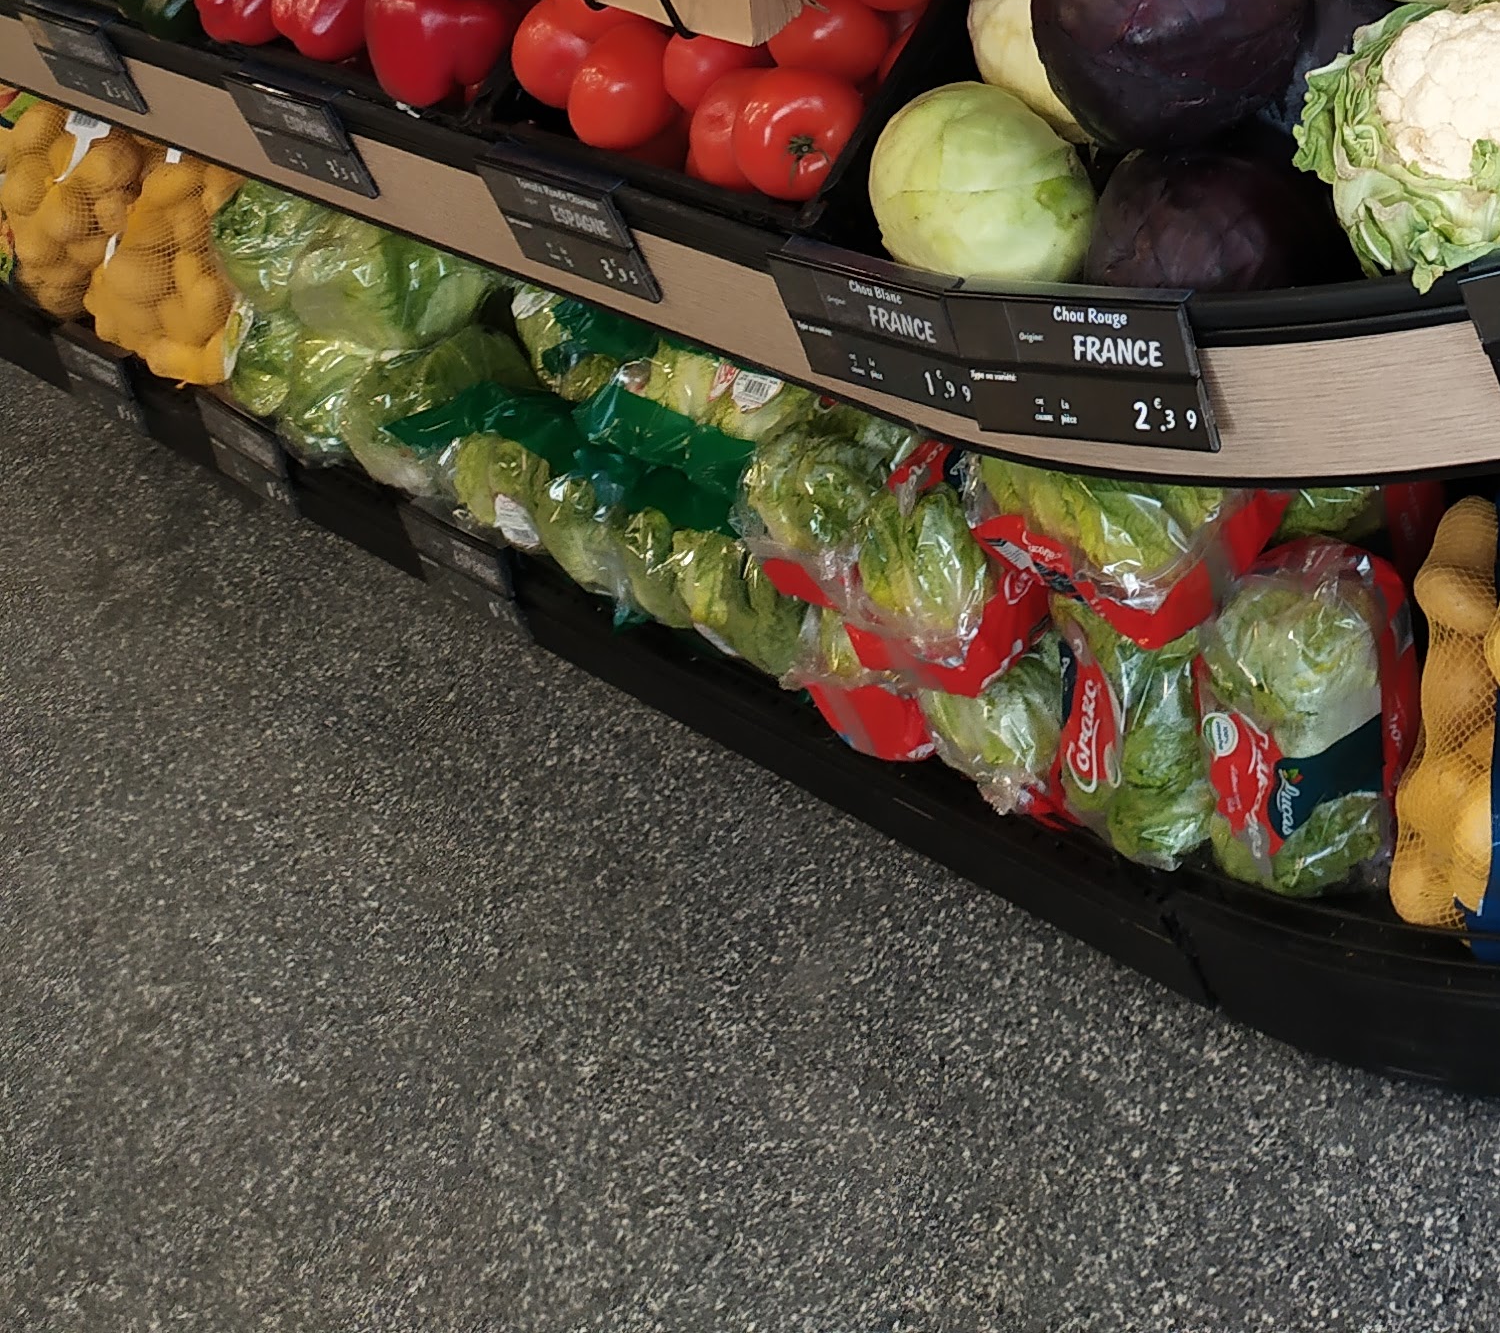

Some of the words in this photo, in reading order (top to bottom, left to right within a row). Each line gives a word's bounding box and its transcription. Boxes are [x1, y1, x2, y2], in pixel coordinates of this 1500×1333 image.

[549, 203, 612, 239] ESPAGNE
[848, 279, 874, 299] Chou
[874, 284, 903, 306] Blanc
[867, 304, 938, 344] FRANCE
[1052, 305, 1086, 324] Chou
[1087, 307, 1129, 329] Rouge
[1072, 334, 1164, 368] FRANCE
[1276, 768, 1300, 835] Lucas
